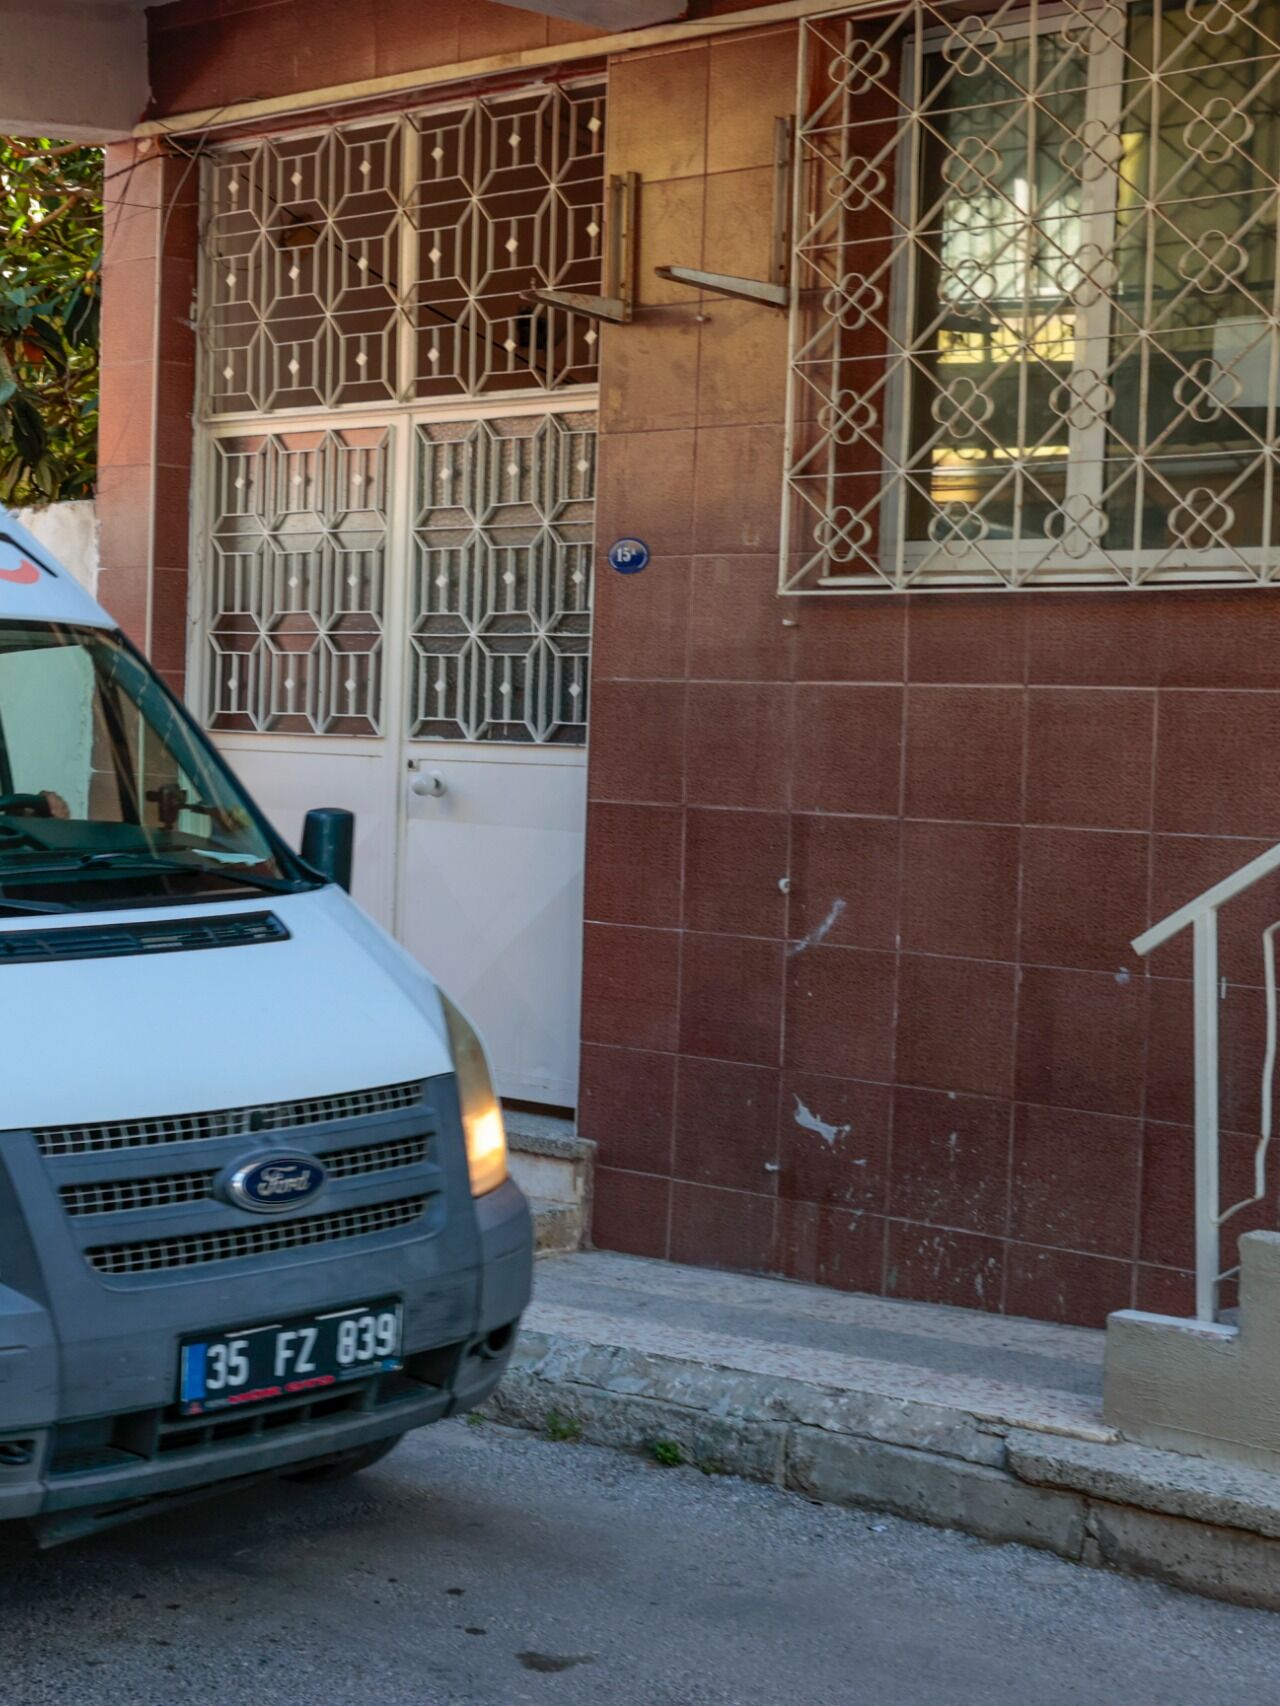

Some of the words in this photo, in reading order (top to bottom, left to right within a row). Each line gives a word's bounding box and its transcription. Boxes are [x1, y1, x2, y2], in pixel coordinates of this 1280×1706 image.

[257, 1165, 312, 1197] Ford
[206, 1339, 249, 1389] 35
[274, 1327, 319, 1376] FZ
[336, 1313, 397, 1364] 839
